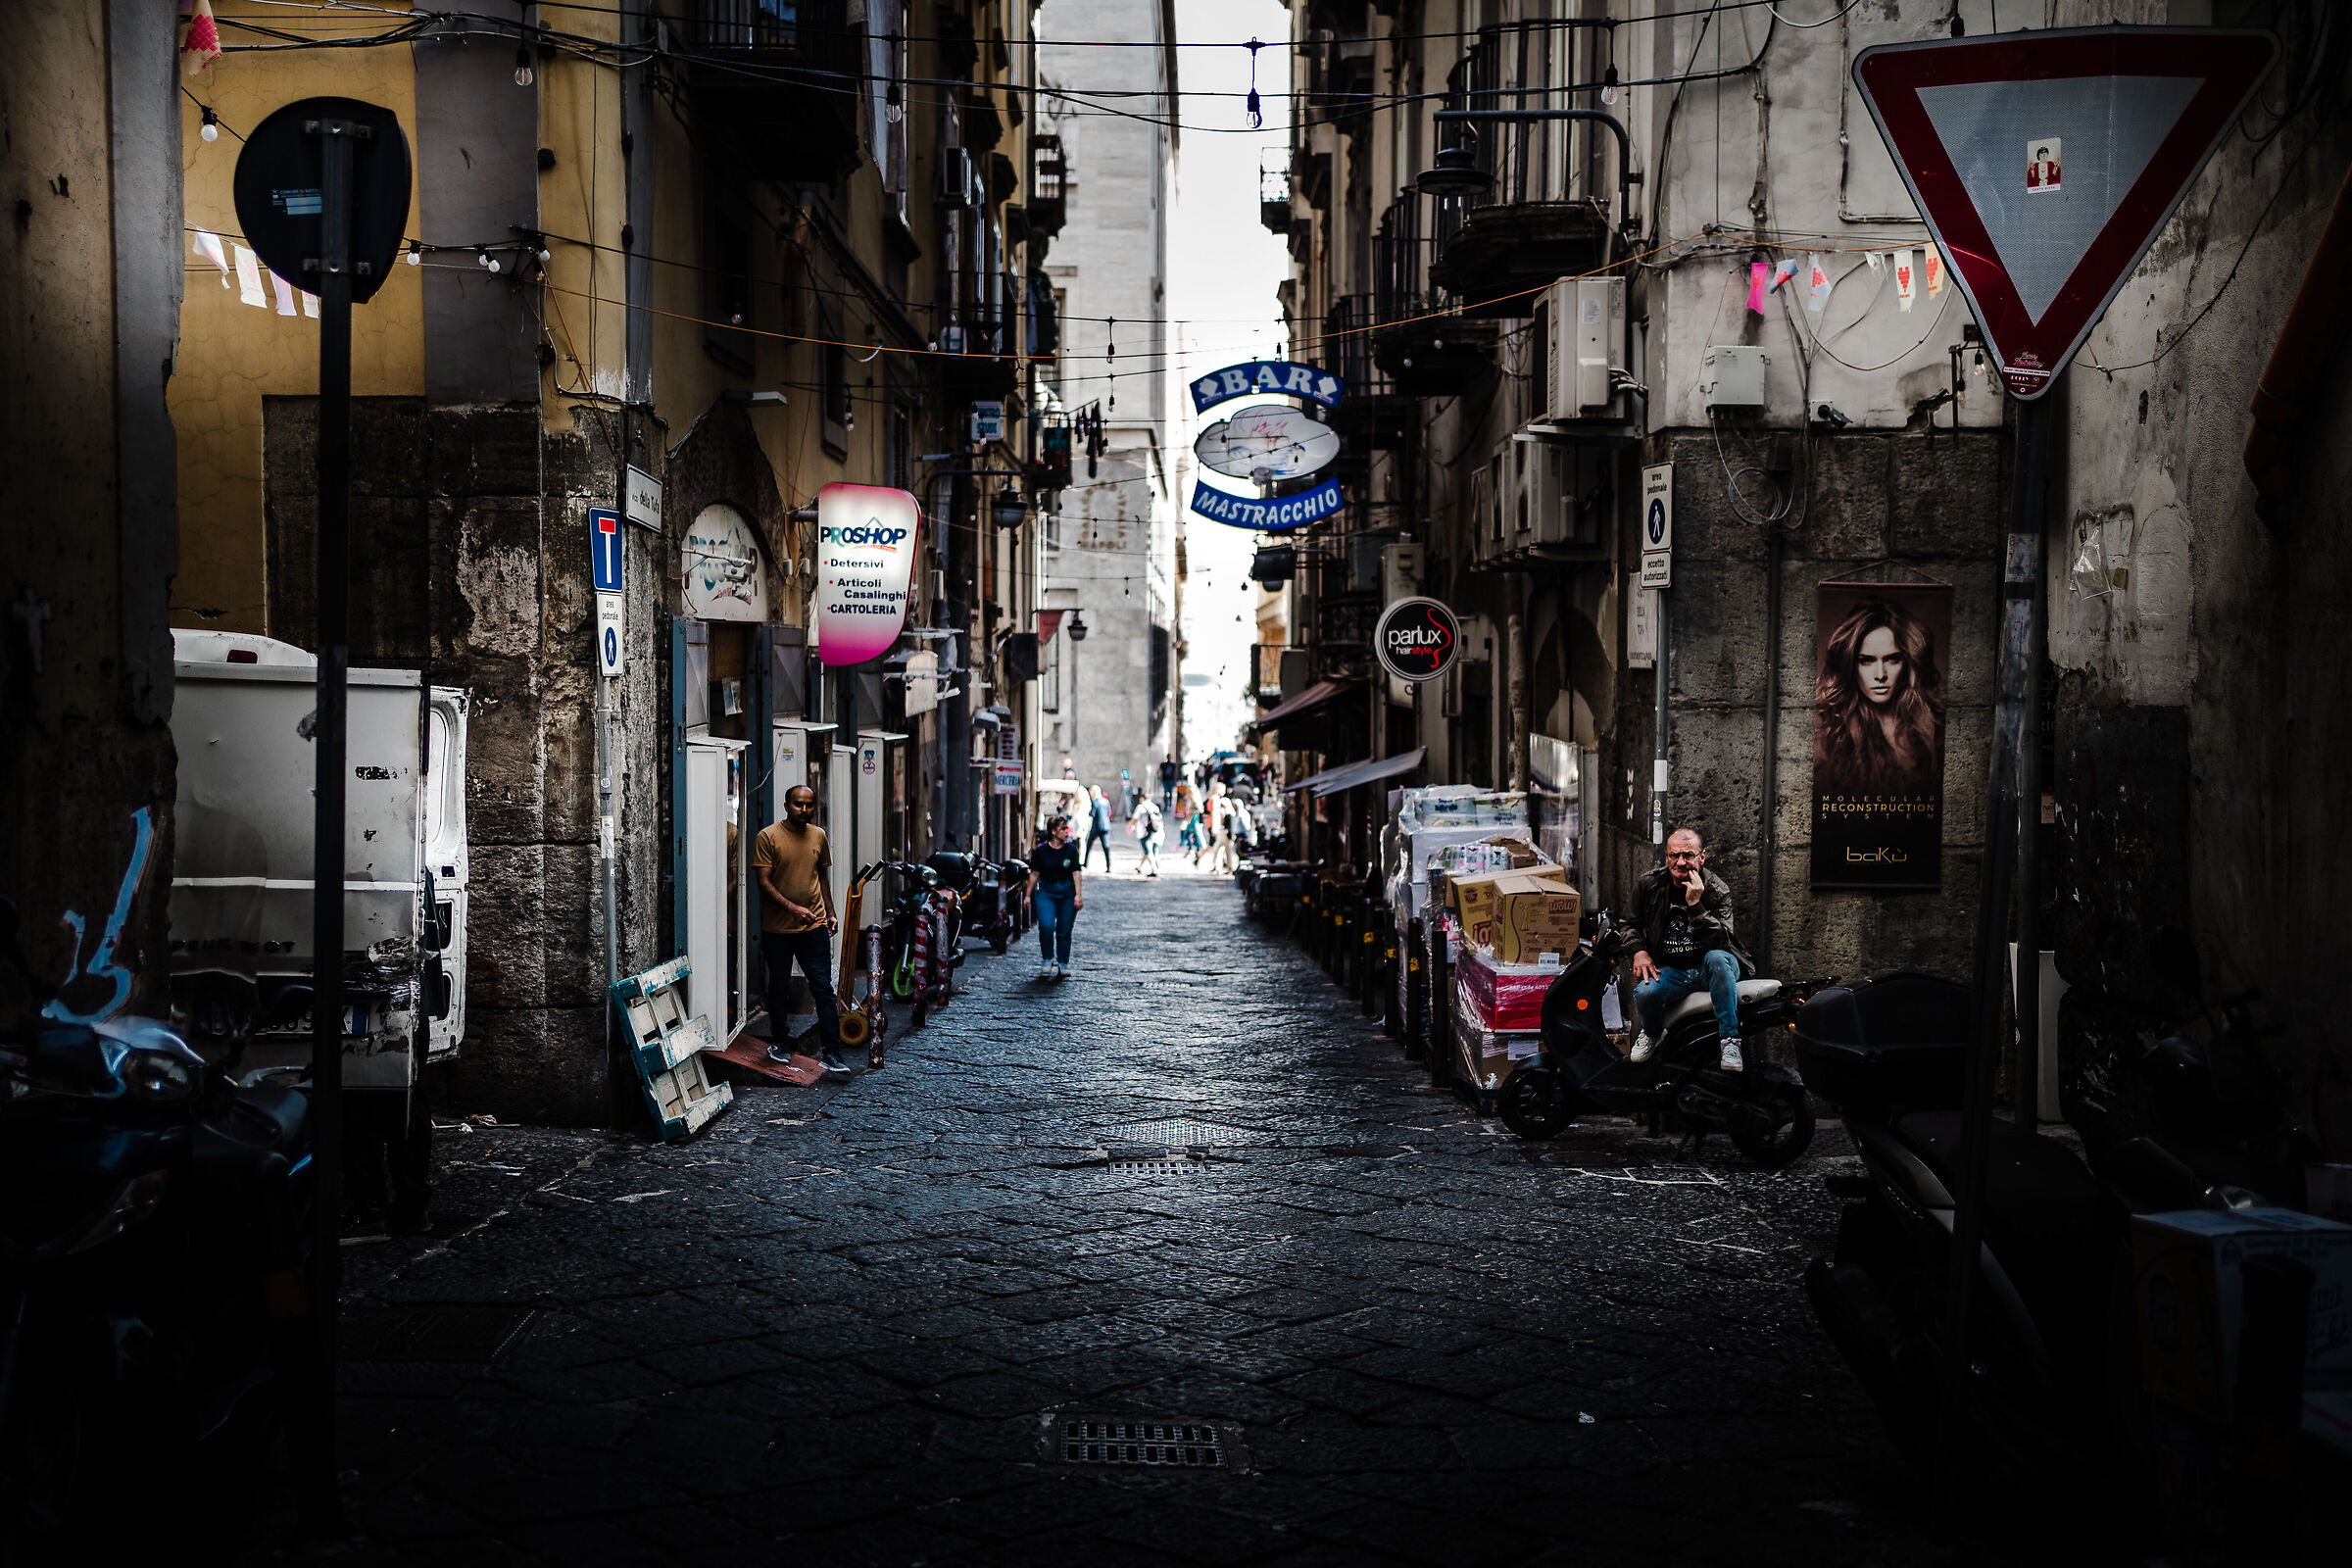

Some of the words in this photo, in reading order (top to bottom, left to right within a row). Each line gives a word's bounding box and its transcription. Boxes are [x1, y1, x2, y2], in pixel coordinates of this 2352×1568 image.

[1220, 366, 1312, 394] BAR
[1647, 483, 1667, 495] pedonale
[1197, 489, 1337, 525] MASTRACCHIO
[820, 526, 906, 547] PROSHOP
[830, 559, 884, 568] Detersivi
[1647, 559, 1664, 568] eccetto
[1643, 569, 1668, 581] autorizzati
[837, 578, 881, 588] Articoli
[844, 590, 906, 602] Casalinghi
[830, 604, 897, 614] CARTOLERIA
[1388, 624, 1442, 649] parlux
[1396, 646, 1433, 657] hairstyle
[1822, 803, 1935, 812] RECONSTRUCTION
